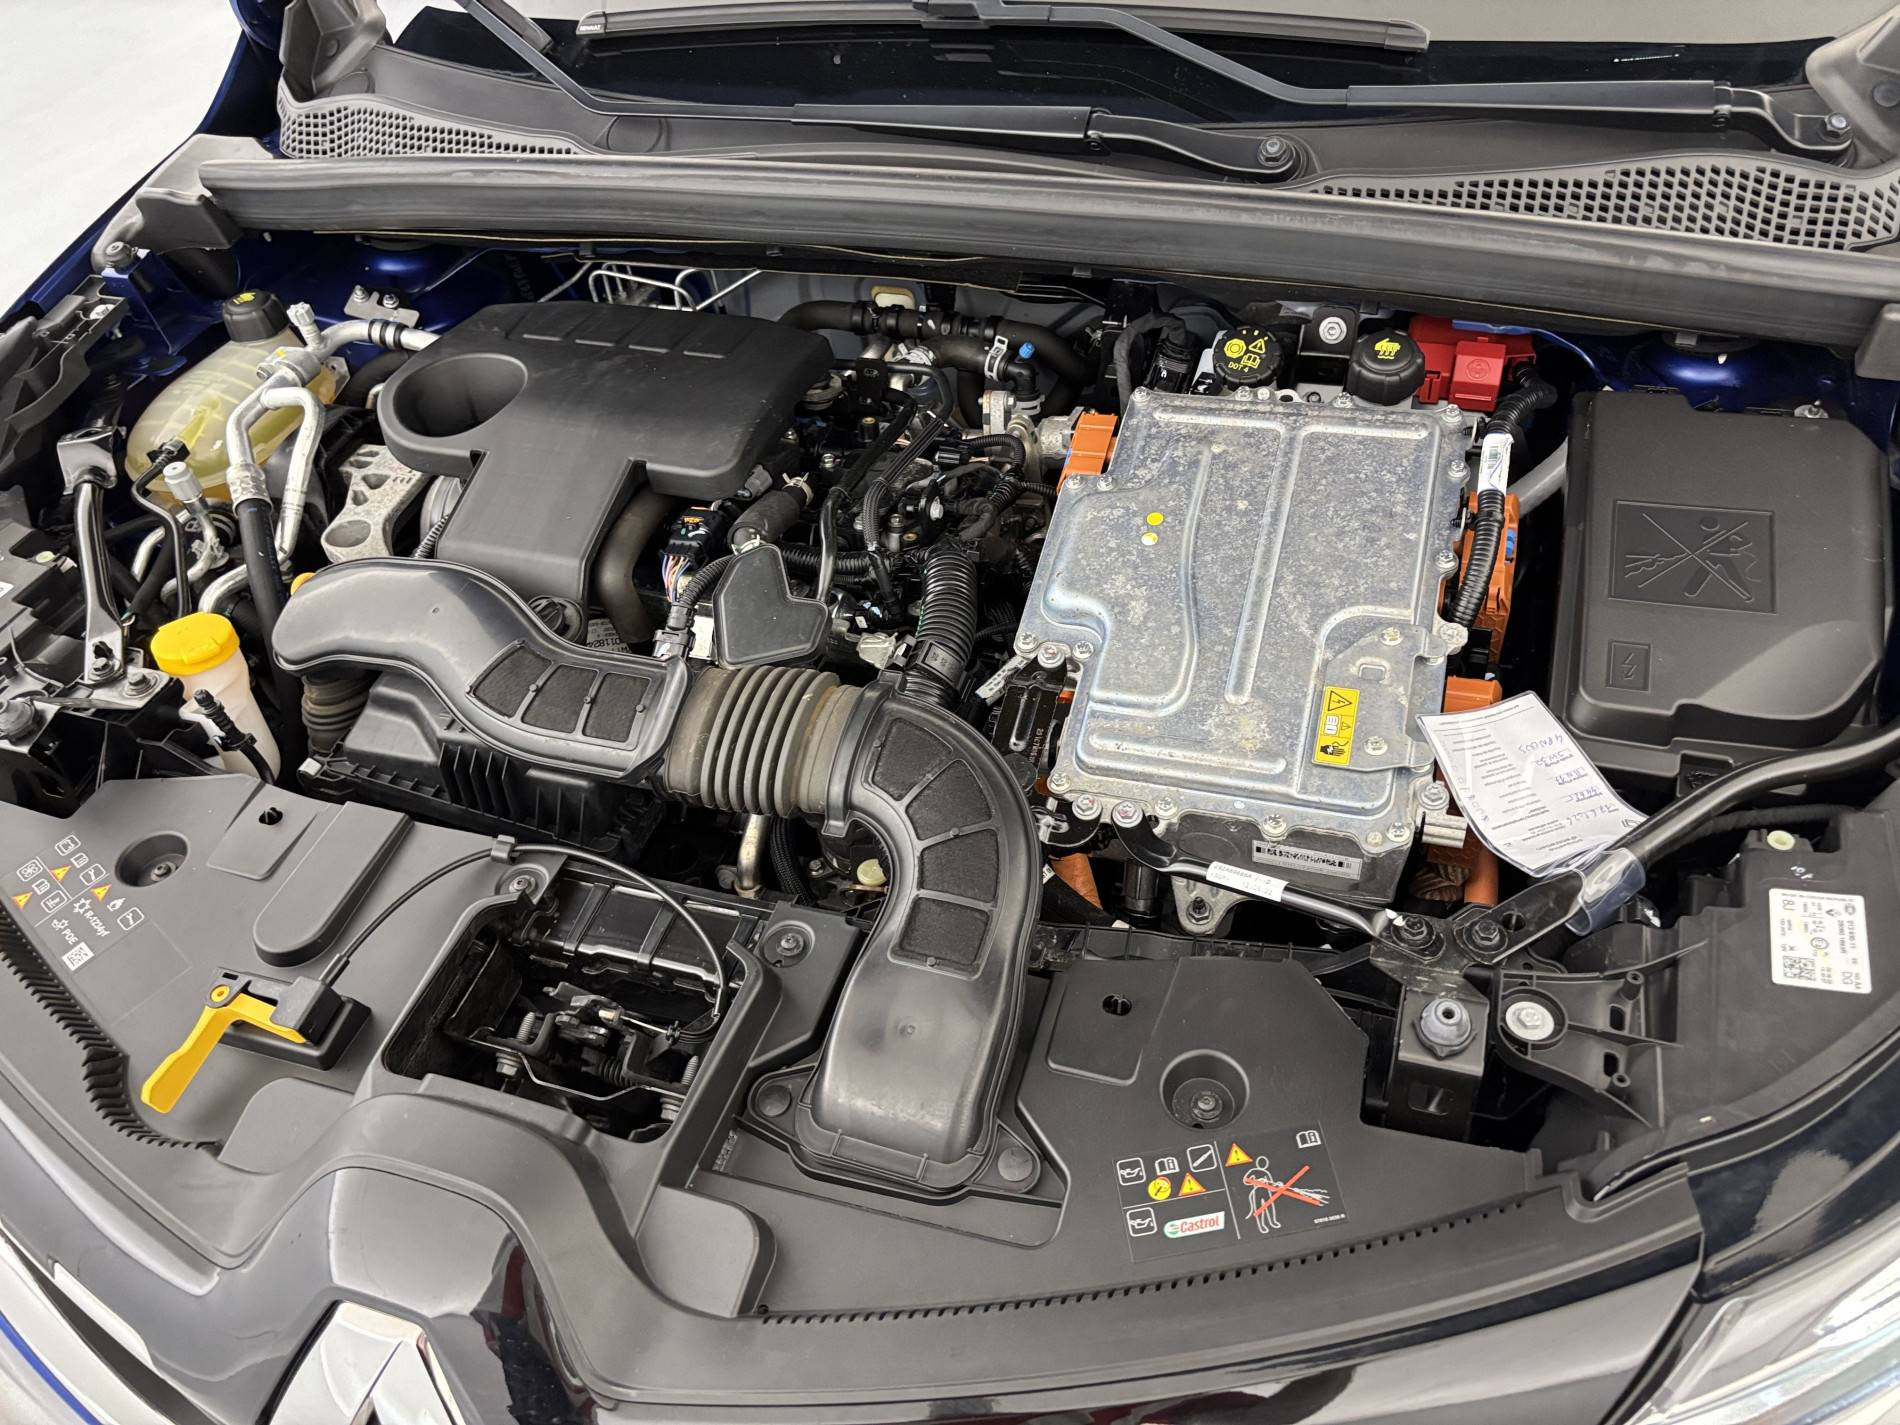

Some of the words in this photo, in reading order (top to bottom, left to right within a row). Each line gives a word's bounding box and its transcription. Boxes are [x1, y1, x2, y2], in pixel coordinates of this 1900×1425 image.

[1228, 361, 1243, 371] DOT
[61, 928, 79, 945] POE
[1180, 1216, 1220, 1234] Castrol
